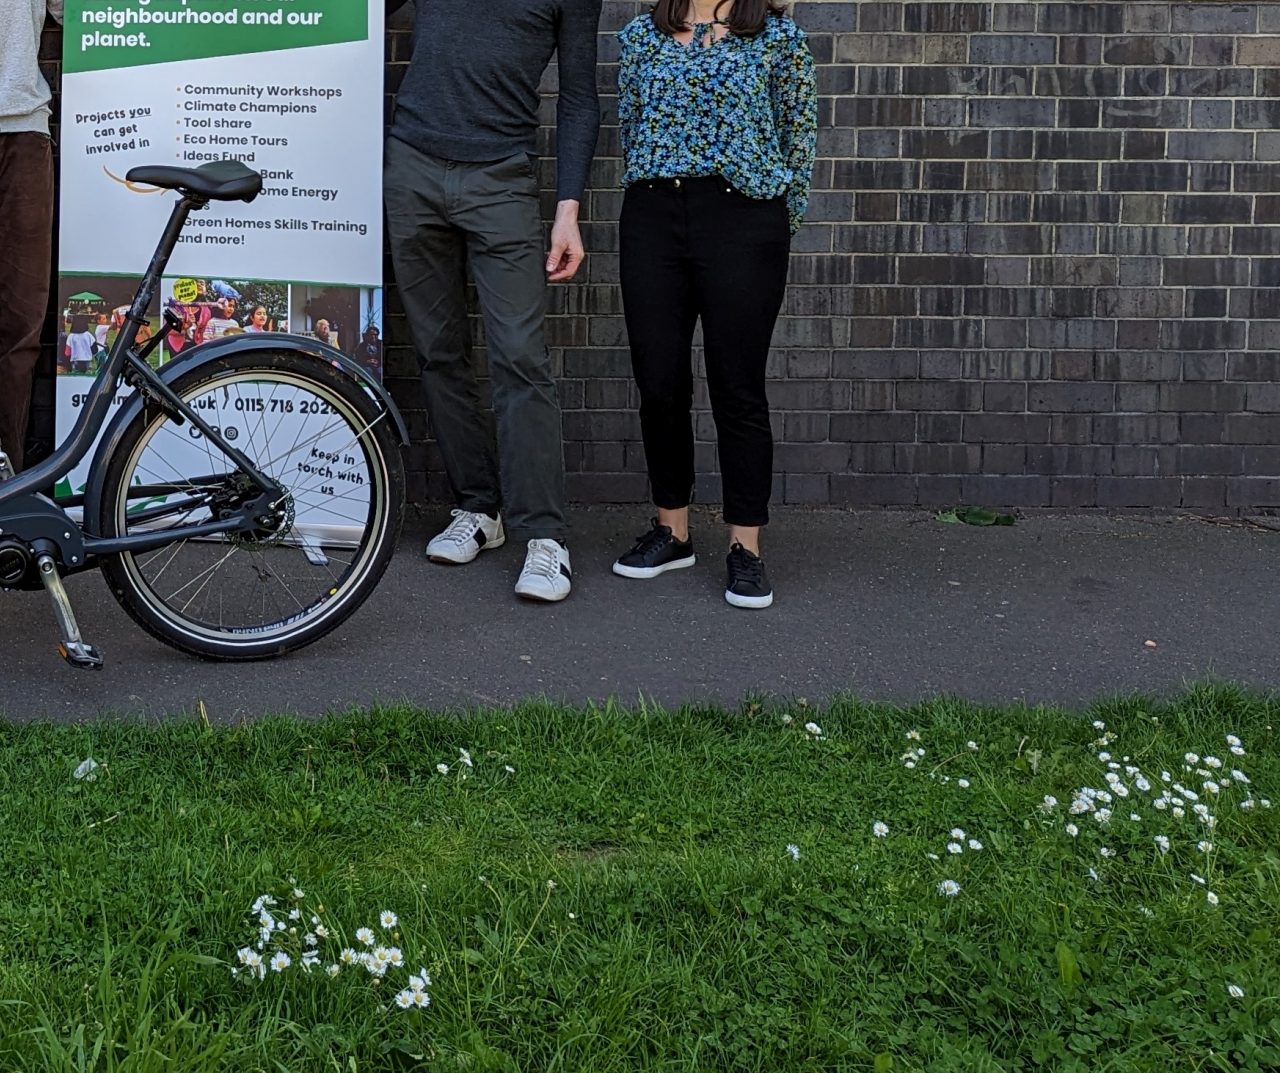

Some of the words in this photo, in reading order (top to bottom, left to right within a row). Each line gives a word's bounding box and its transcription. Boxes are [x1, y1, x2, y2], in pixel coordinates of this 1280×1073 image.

[82, 8, 237, 28] neighbourhood
[242, 9, 283, 25] and
[287, 12, 322, 25] our
[81, 32, 151, 51] planet.
[184, 85, 264, 98] Community
[267, 86, 342, 100] Workshops
[184, 101, 236, 112] Climate
[239, 102, 317, 115] Champions
[76, 110, 125, 124] Projects
[129, 108, 151, 119] you
[184, 118, 211, 127] Tool
[214, 118, 252, 128] share
[94, 128, 115, 138] can
[119, 124, 138, 137] get
[86, 139, 135, 154] involved
[139, 138, 150, 147] in
[184, 134, 206, 144] Eco
[209, 135, 248, 145] Home
[251, 136, 288, 146] Tours
[184, 151, 219, 161] Ideas
[223, 152, 255, 162] Fund
[260, 169, 294, 180] Bank
[260, 188, 288, 197] ome
[292, 187, 338, 201] Energy
[184, 217, 222, 227] Green
[225, 218, 271, 229] Homes
[275, 220, 308, 230] Skills
[311, 221, 367, 235] Training
[177, 233, 202, 243] and
[205, 235, 245, 245] more!
[234, 398, 264, 412] 0115
[270, 398, 294, 414] 718
[311, 448, 339, 464] Keep
[344, 454, 355, 464] in
[298, 462, 332, 479] touch
[338, 471, 363, 484] with
[321, 486, 334, 495] us
